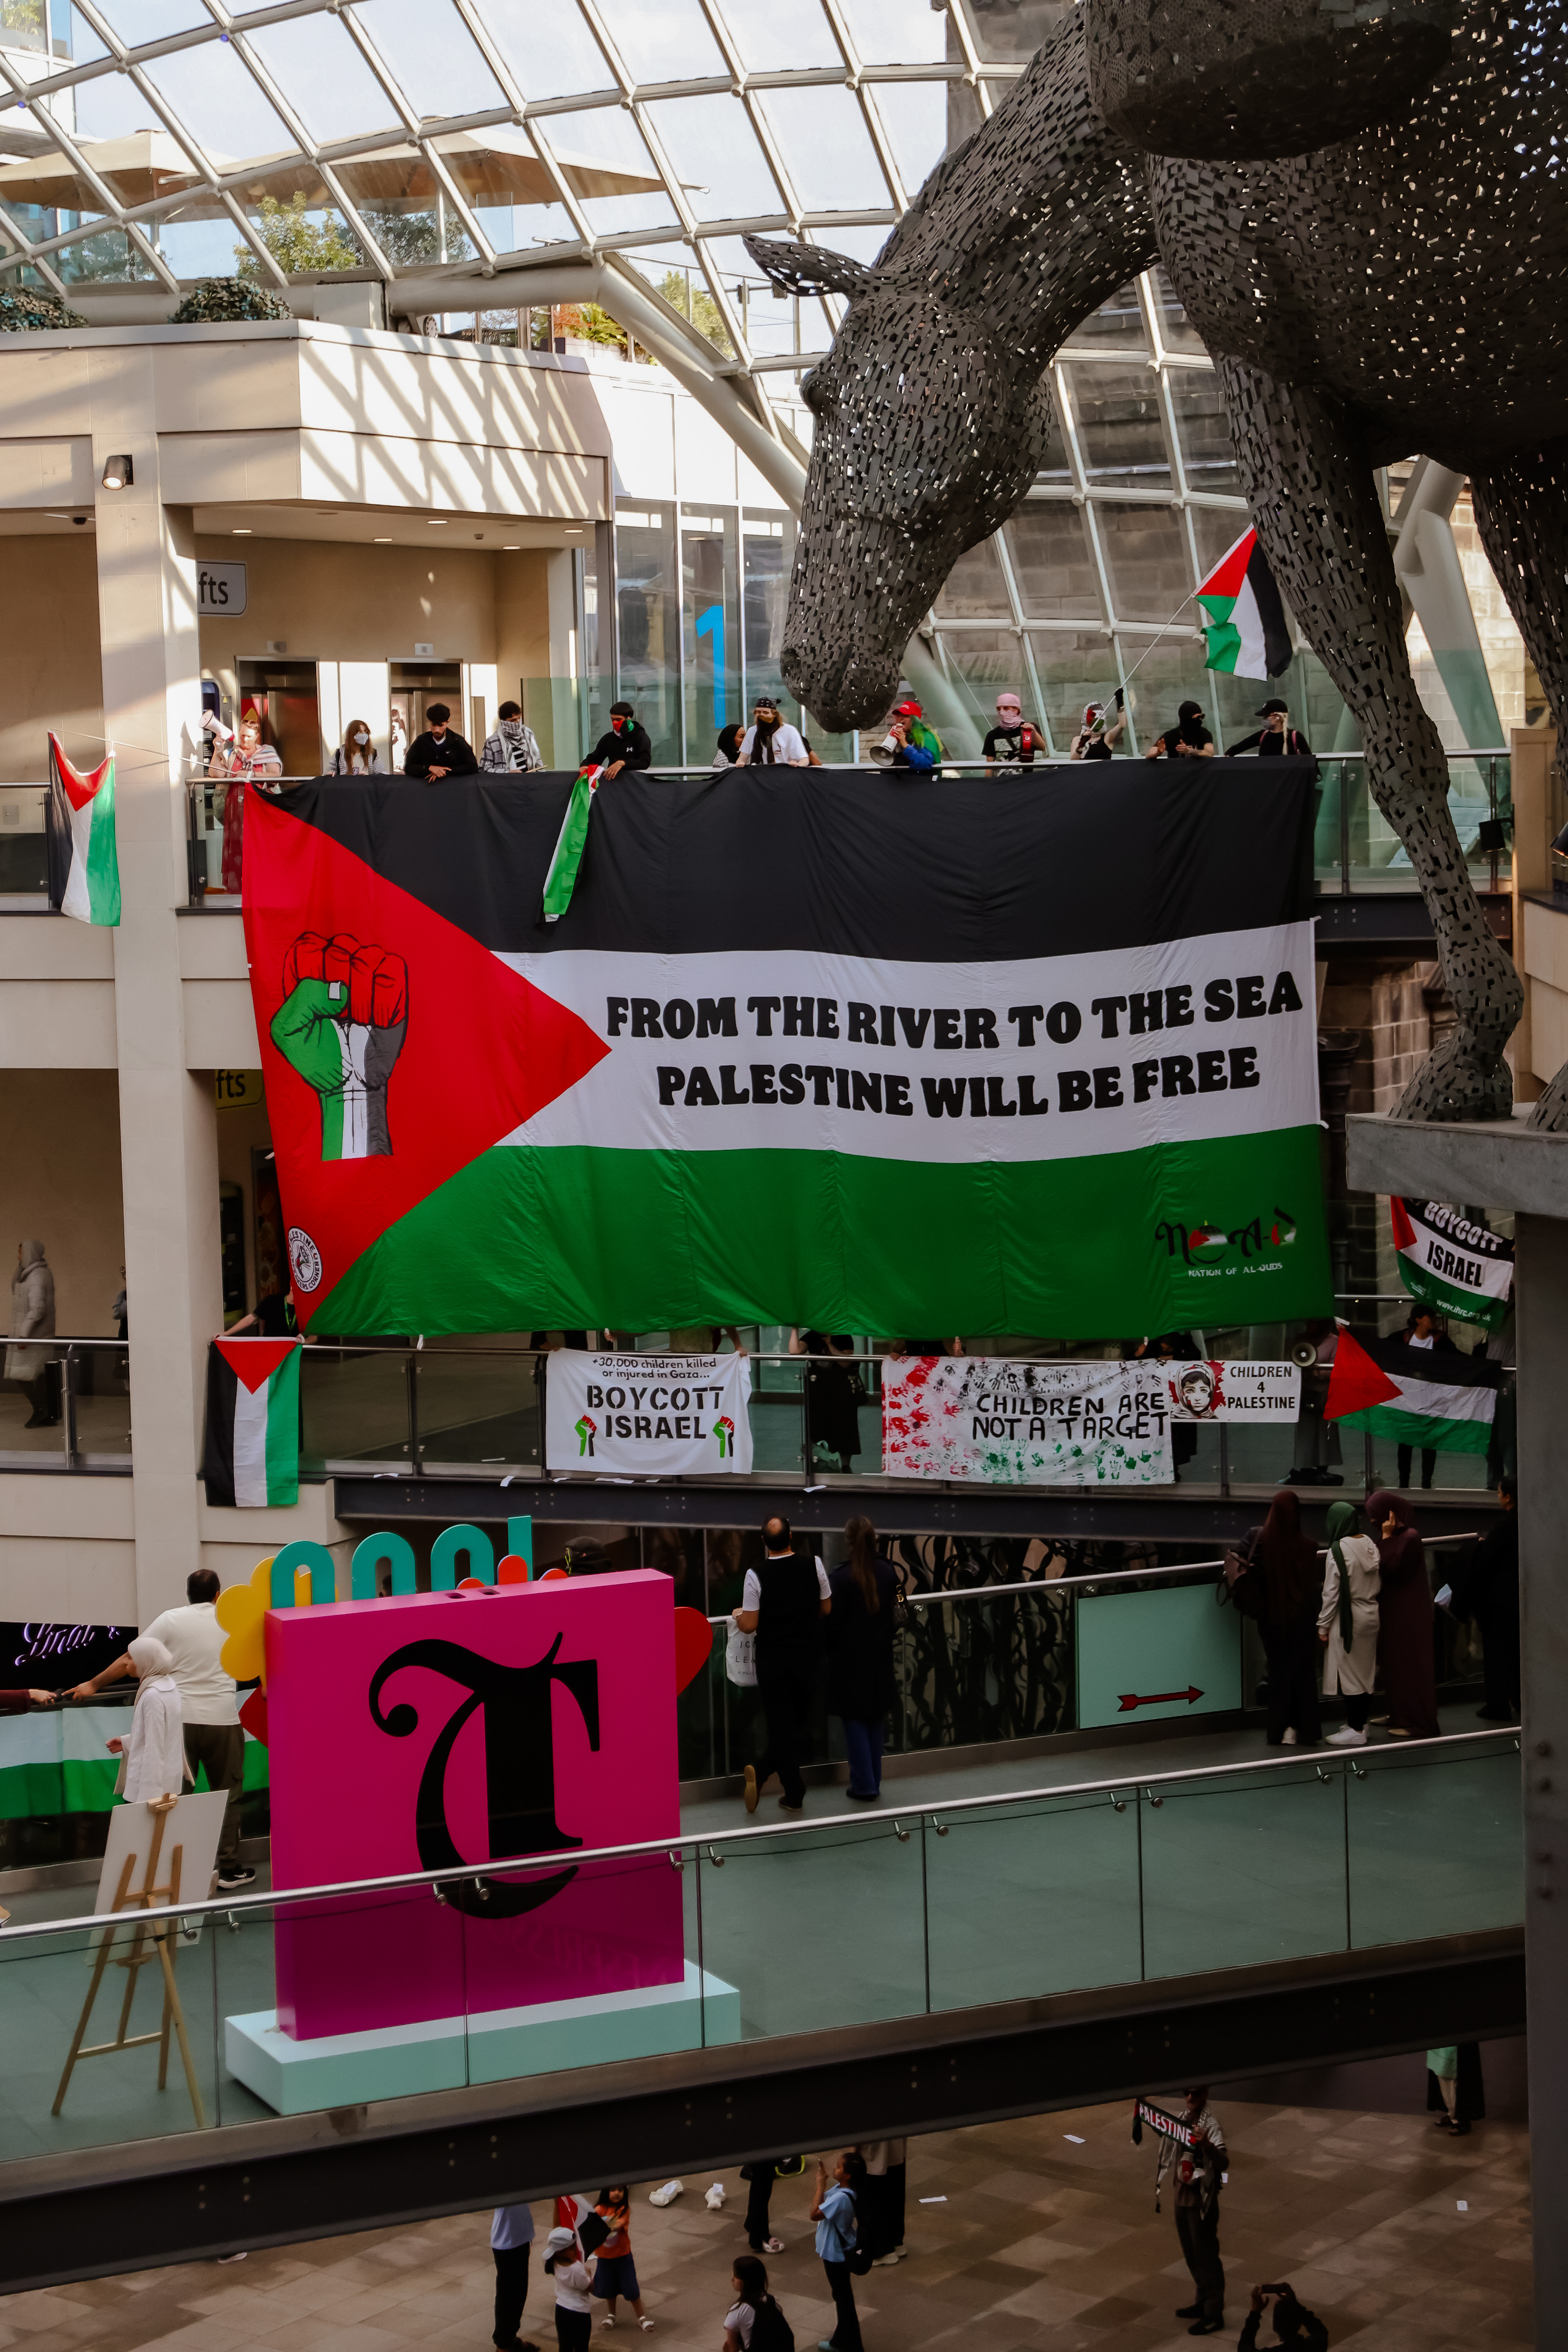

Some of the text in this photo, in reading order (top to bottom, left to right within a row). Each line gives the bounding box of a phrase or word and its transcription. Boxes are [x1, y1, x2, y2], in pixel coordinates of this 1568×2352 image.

[695, 605, 725, 729] 1
[607, 971, 1303, 1049] FROM THE RIVER TO THE SEA
[657, 1047, 1260, 1118] PALESTINE WILL BE FREE
[1424, 1201, 1503, 1252] BOYCOTT
[308, 1261, 320, 1289] CORNER
[1188, 1269, 1221, 1277] NATION
[1243, 1262, 1283, 1273] AL-QUDS
[1426, 1240, 1482, 1287] ISRAEL
[1437, 1299, 1491, 1321] www.ihrc.orguk
[592, 1357, 717, 1368] +30,000 children killed
[617, 1368, 654, 1380] injured
[657, 1370, 667, 1378] in
[670, 1369, 710, 1379] Gaza...
[1230, 1365, 1292, 1378] CHILDREN
[587, 1385, 724, 1411] BOYCOTT
[1257, 1381, 1265, 1393] 4
[976, 1392, 1165, 1416] CHILDREN ARE
[1228, 1396, 1295, 1409] PALESTINE
[605, 1414, 706, 1439] ISRAEL
[973, 1411, 1168, 1441] NOT A TARGET
[369, 1632, 599, 1919] T
